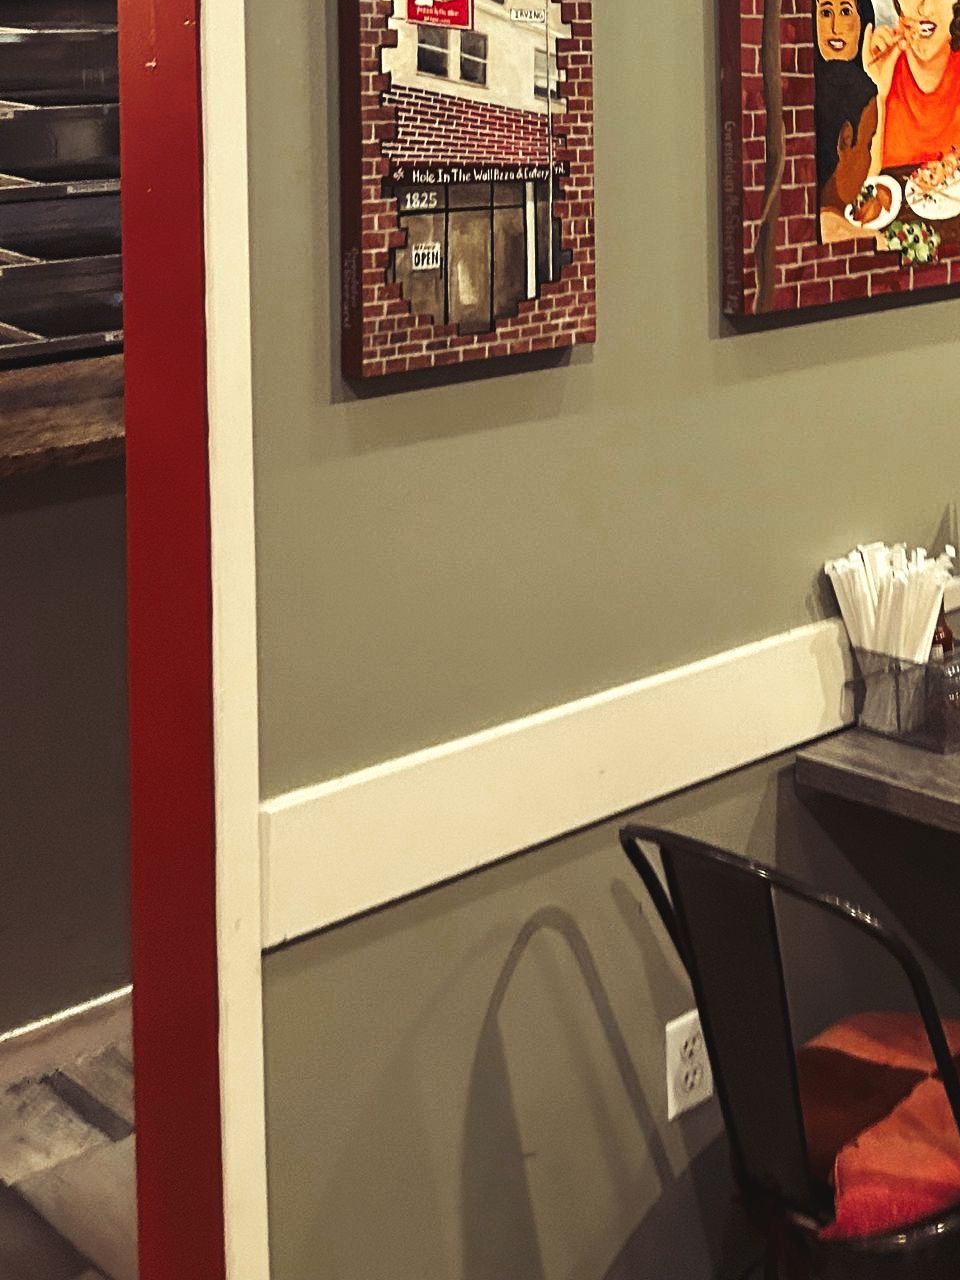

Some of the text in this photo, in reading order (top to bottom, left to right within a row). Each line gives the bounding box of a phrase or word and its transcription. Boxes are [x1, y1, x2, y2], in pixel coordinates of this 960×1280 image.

[412, 168, 436, 184] Hole
[436, 168, 451, 184] In
[451, 167, 471, 182] The
[473, 167, 493, 182] Wall
[405, 191, 438, 209] 1825
[414, 250, 439, 267] OPEN
